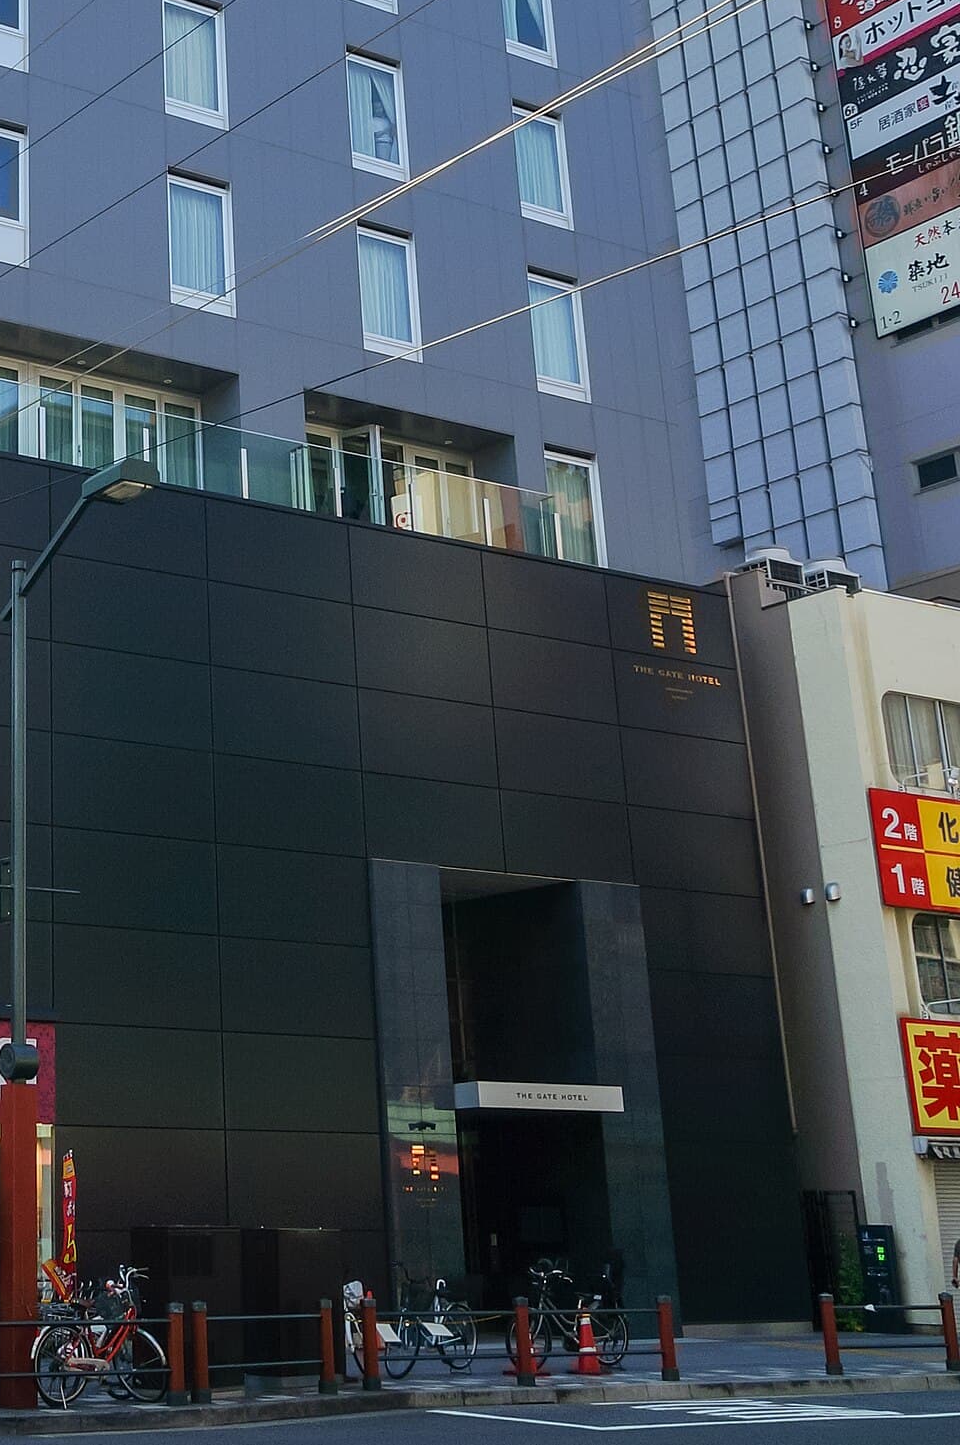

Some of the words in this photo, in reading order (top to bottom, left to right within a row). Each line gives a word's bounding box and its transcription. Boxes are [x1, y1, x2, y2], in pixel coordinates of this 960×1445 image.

[834, 16, 841, 28] 8
[850, 117, 863, 130] 5F
[859, 183, 869, 196] 4
[688, 673, 721, 686] HOTEL
[881, 807, 918, 841] 2階
[890, 863, 925, 896] 1階
[516, 1092, 532, 1100] THE
